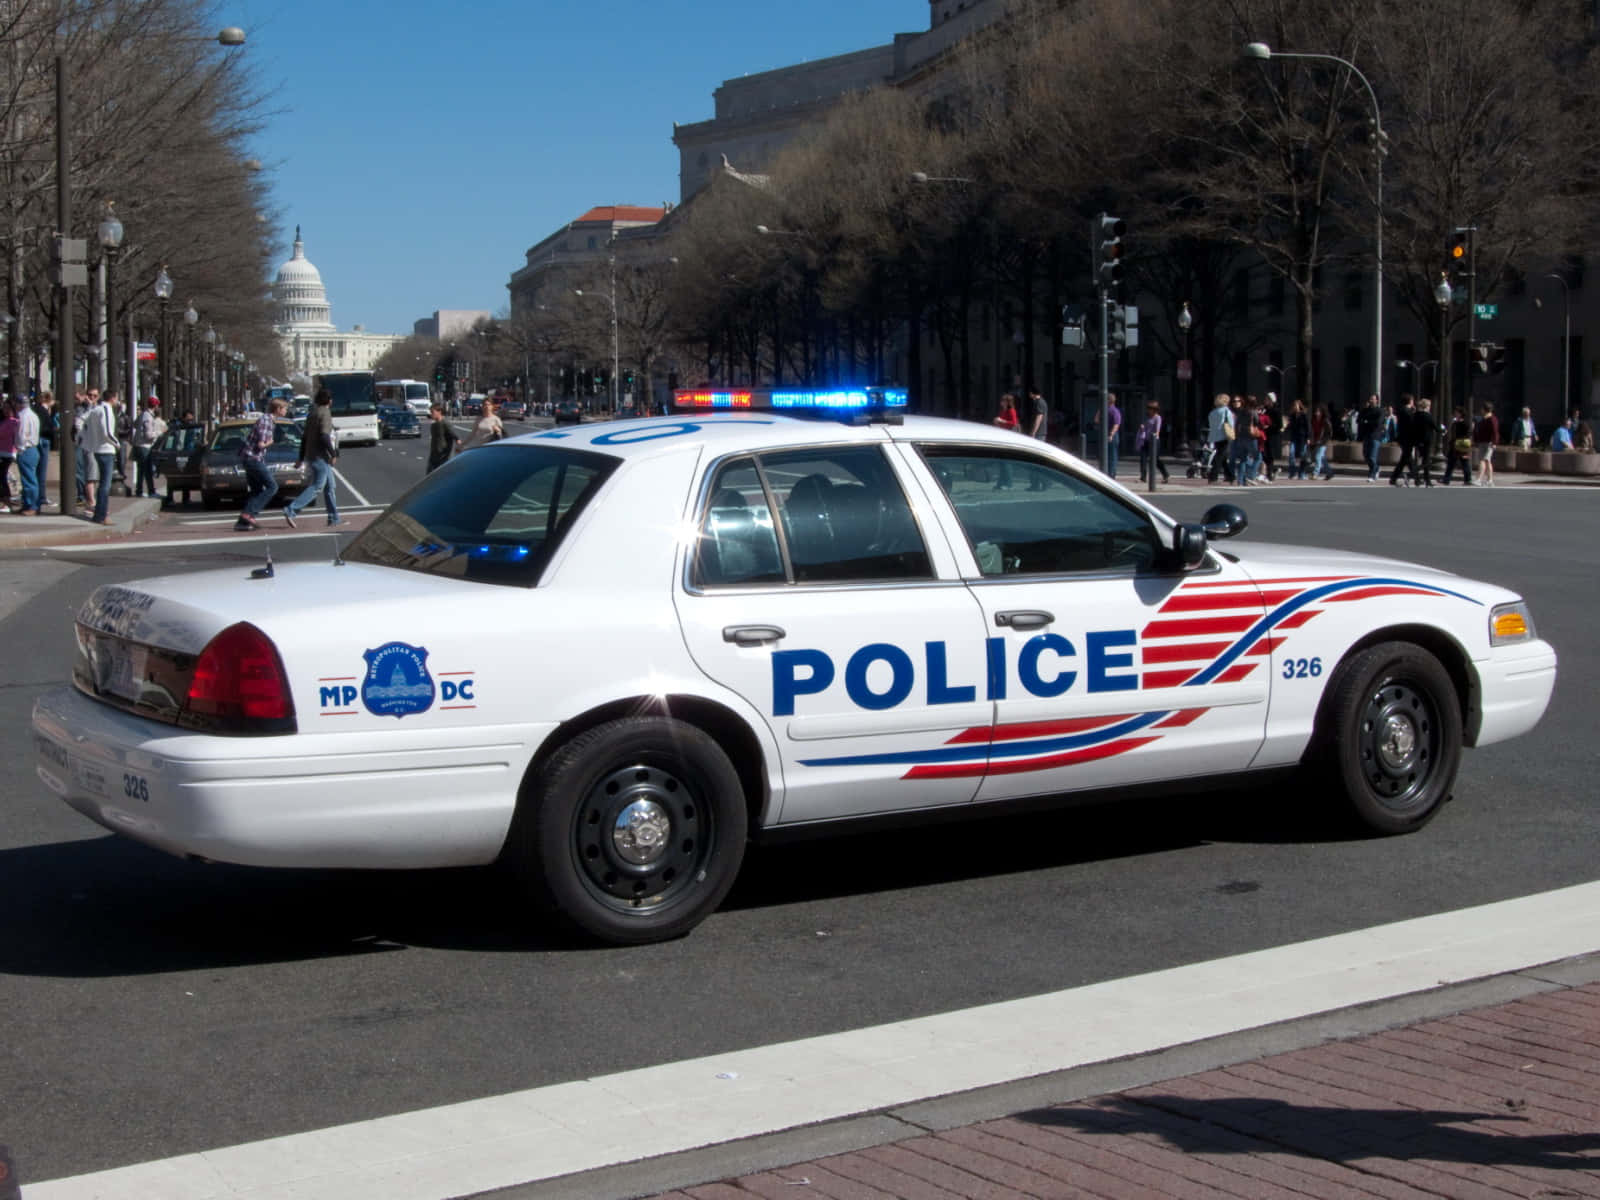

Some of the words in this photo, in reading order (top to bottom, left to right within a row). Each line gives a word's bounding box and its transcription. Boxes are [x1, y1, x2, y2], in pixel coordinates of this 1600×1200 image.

[371, 646, 410, 680] METROPOLITAN
[411, 653, 426, 678] POLICE
[771, 629, 1139, 717] POLICE
[1282, 656, 1322, 680] 326
[319, 685, 358, 708] MP
[440, 679, 475, 701] DC
[123, 773, 149, 802] 326
